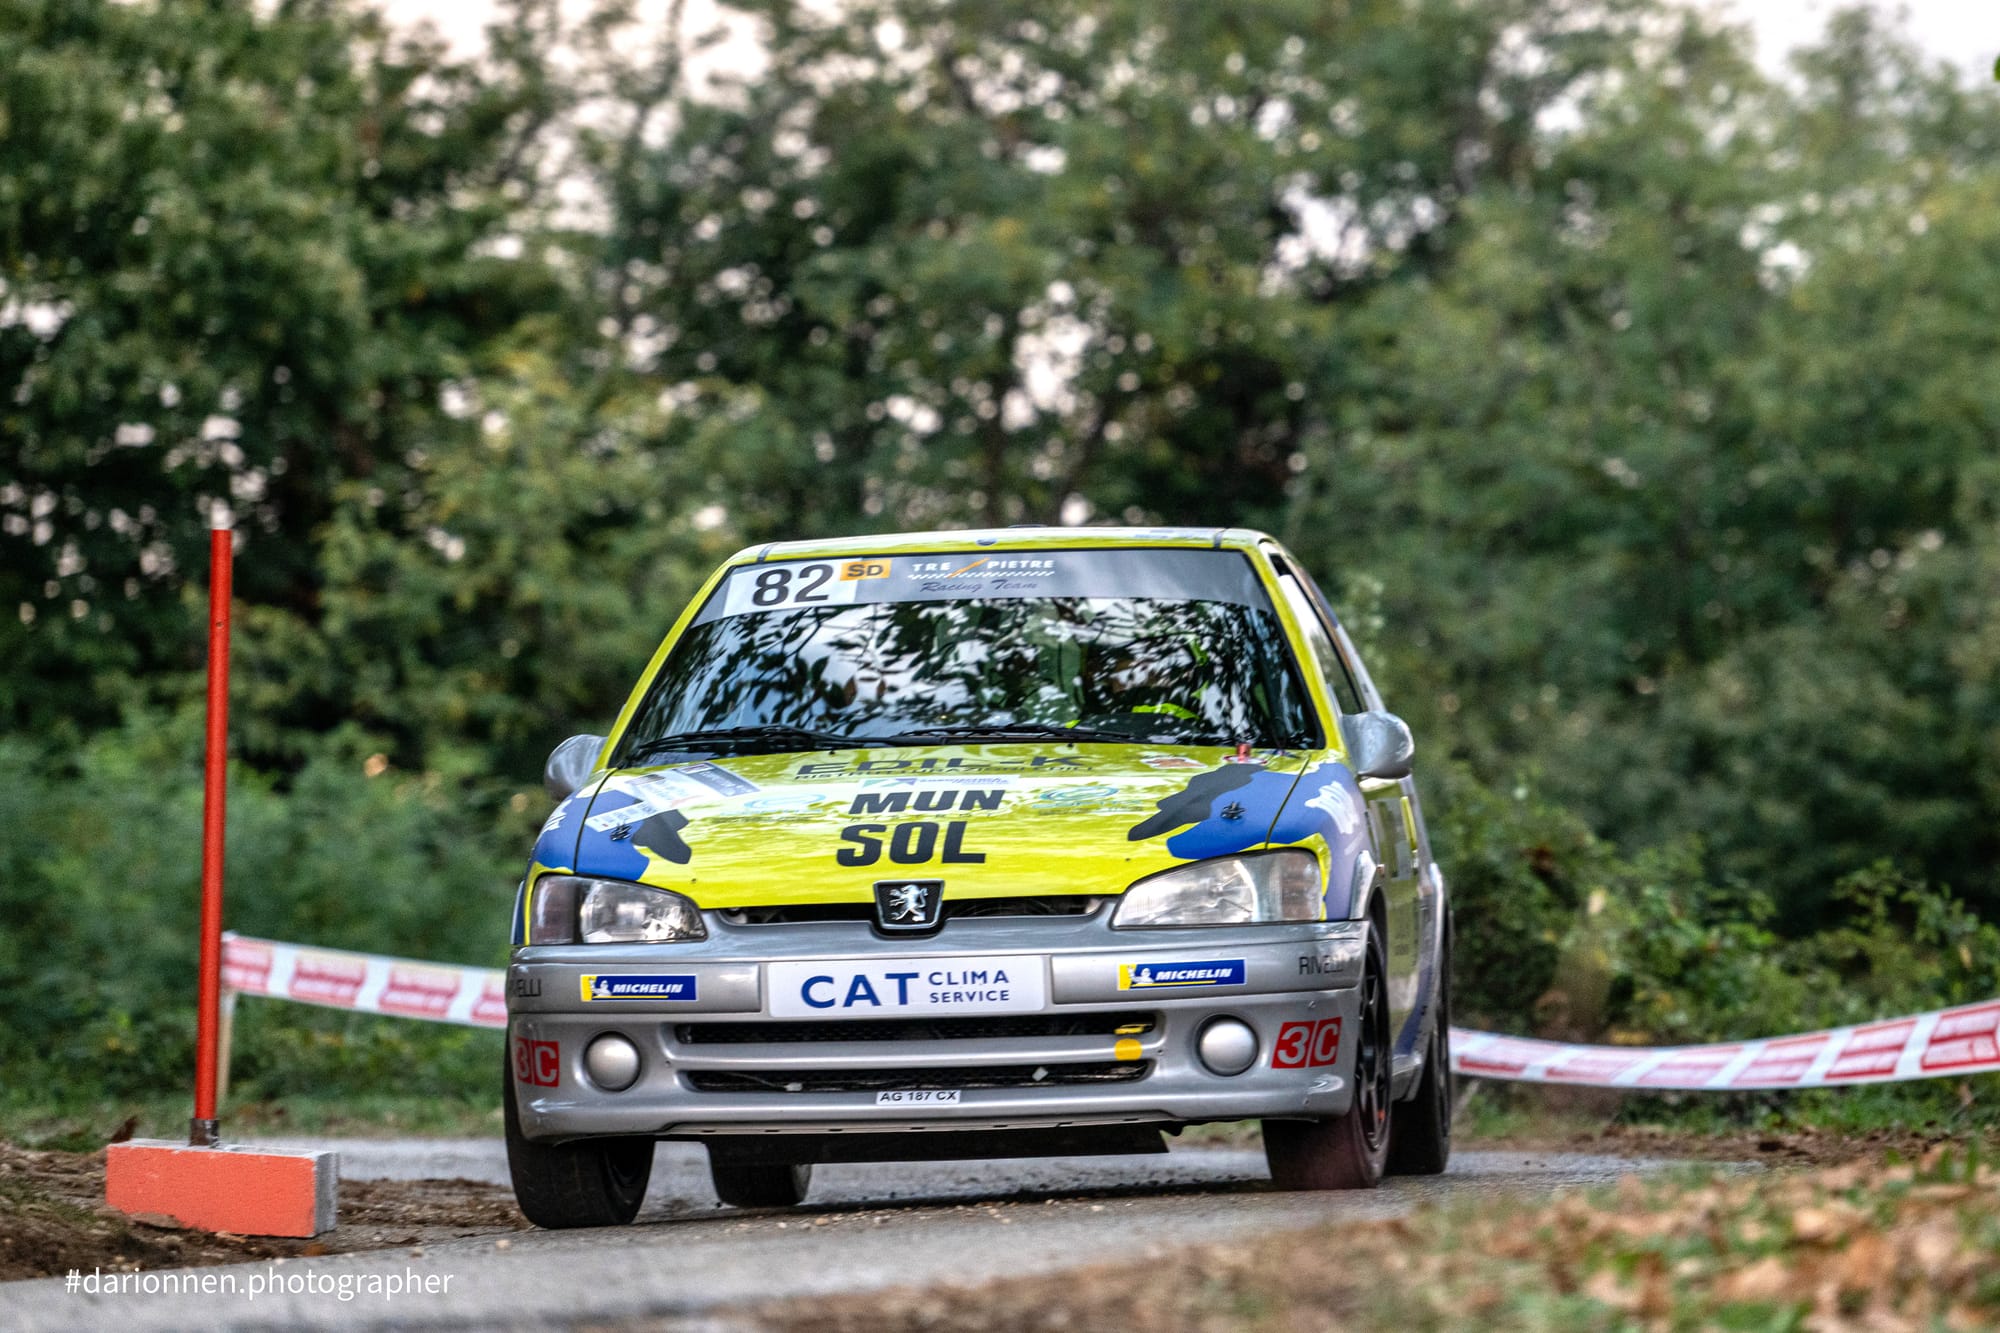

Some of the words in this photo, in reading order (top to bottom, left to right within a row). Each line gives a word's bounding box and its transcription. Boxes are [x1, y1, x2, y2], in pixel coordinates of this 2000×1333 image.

[847, 563, 883, 578] SD
[912, 562, 951, 572] TRE
[987, 560, 1054, 569] PIETRE
[752, 565, 834, 606] 82
[919, 581, 982, 593] Racing
[991, 579, 1037, 590] Team
[797, 756, 1086, 775] EDIL-K
[848, 790, 1005, 814] MUN
[836, 821, 986, 867] SOL
[928, 970, 1009, 986] CLIMA
[1155, 968, 1233, 981] MICHELIN
[613, 984, 683, 993] MICHELIN
[801, 972, 919, 1008] CAT
[930, 990, 1010, 1003] SERVICE
[1277, 1023, 1339, 1064] 3C
[517, 1041, 557, 1083] 3C
[880, 1092, 902, 1101] AG
[910, 1091, 932, 1100] 187
[936, 1090, 956, 1100] CX
